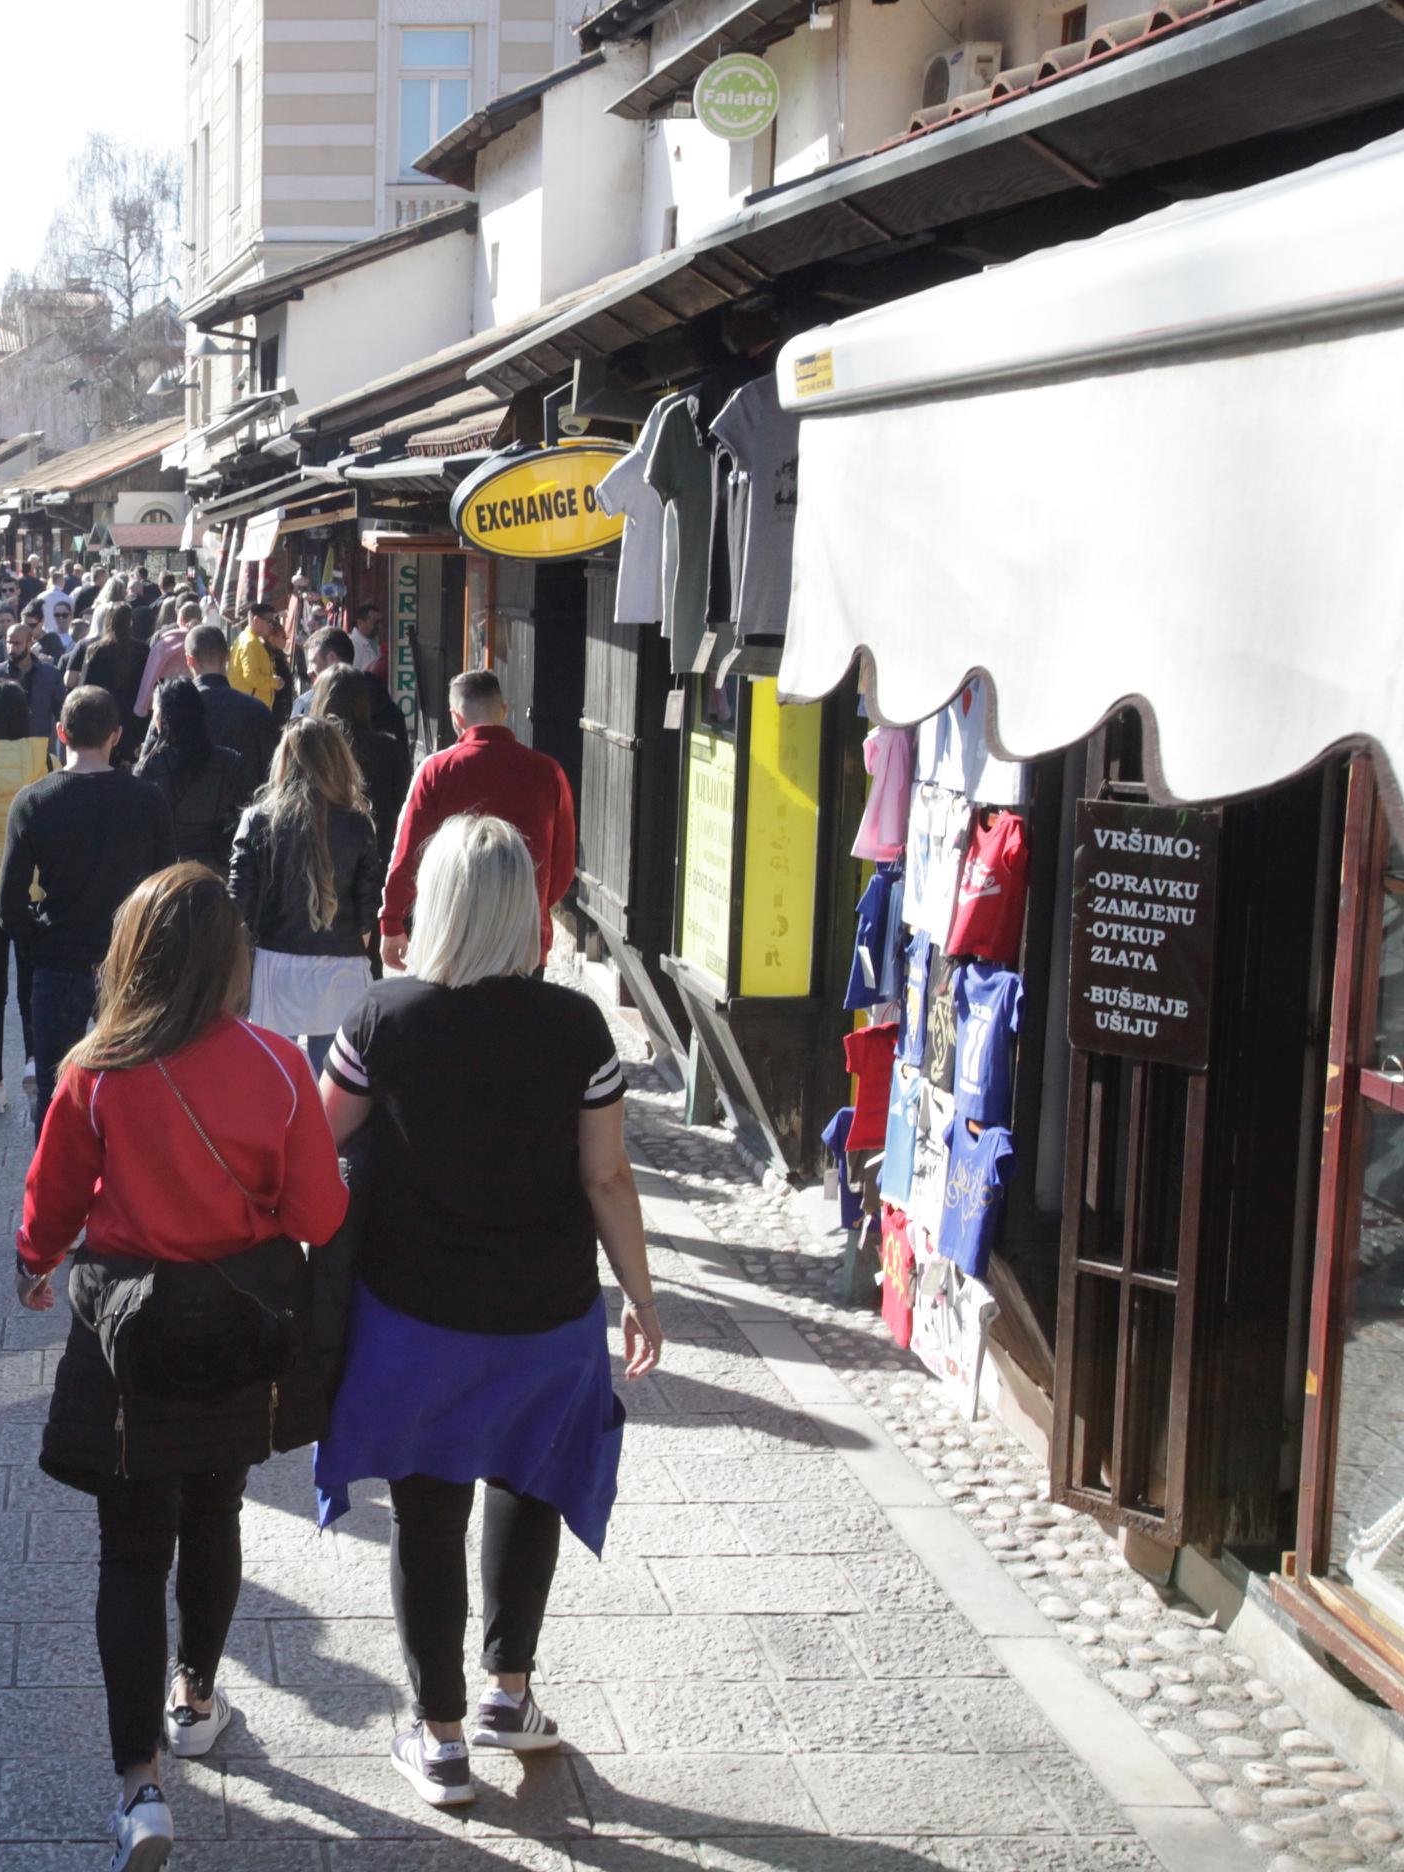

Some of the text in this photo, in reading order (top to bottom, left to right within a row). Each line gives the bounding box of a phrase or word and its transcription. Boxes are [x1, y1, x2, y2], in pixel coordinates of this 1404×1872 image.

[703, 88, 773, 107] Falafel
[475, 488, 578, 533] EXCHANGE
[1093, 827, 1201, 861] VRŠIMO:
[1088, 871, 1200, 901] -OPRAVKU
[1087, 896, 1196, 926] -ZAMJENU
[1085, 921, 1166, 947] -OTKUP
[1090, 945, 1158, 972] ZLATA
[1083, 985, 1189, 1018] -BUŠENJE
[1094, 1010, 1158, 1038] UŠIJU
